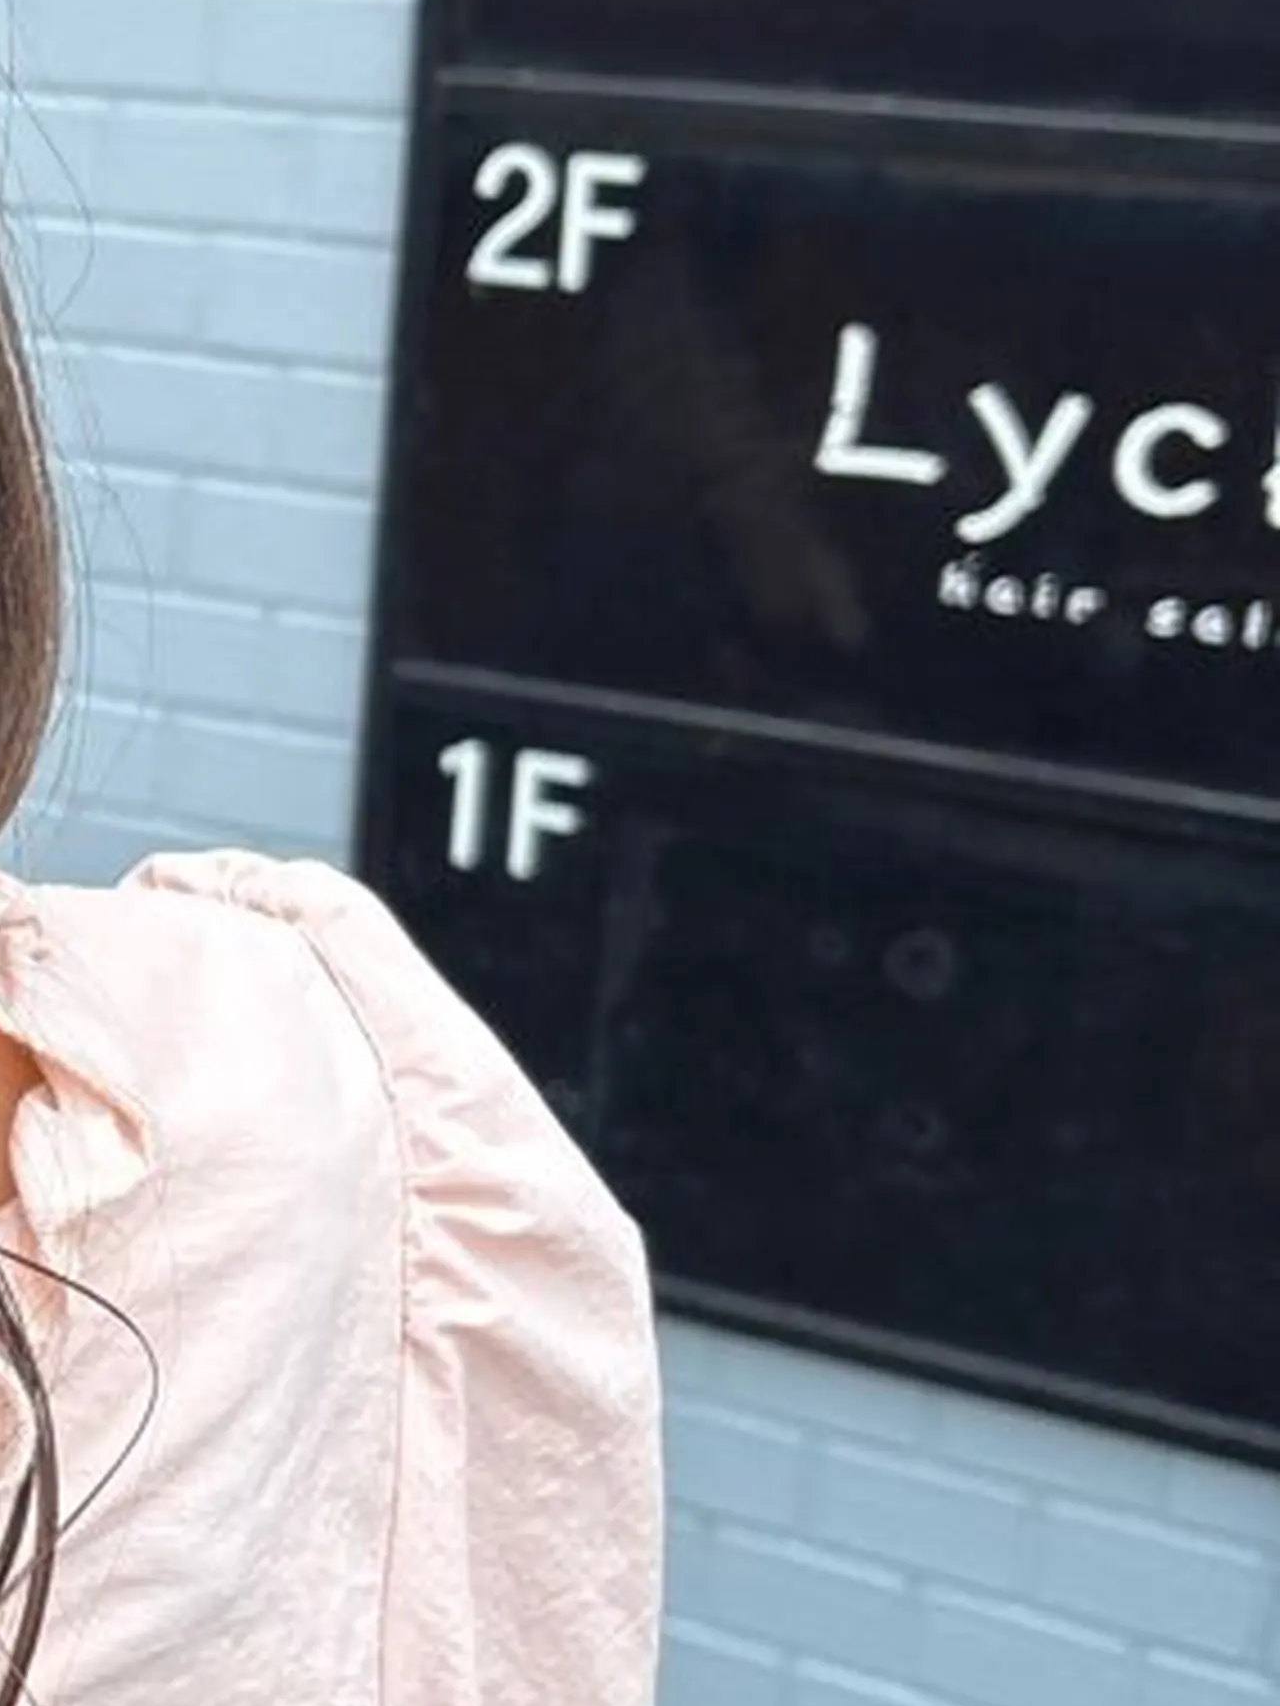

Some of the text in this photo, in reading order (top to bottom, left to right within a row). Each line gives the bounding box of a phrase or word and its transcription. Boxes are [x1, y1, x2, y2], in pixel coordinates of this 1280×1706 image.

[466, 143, 645, 293] 2F
[813, 323, 1280, 544] Lyc
[1145, 596, 1280, 650] sal
[438, 738, 591, 880] 1F
